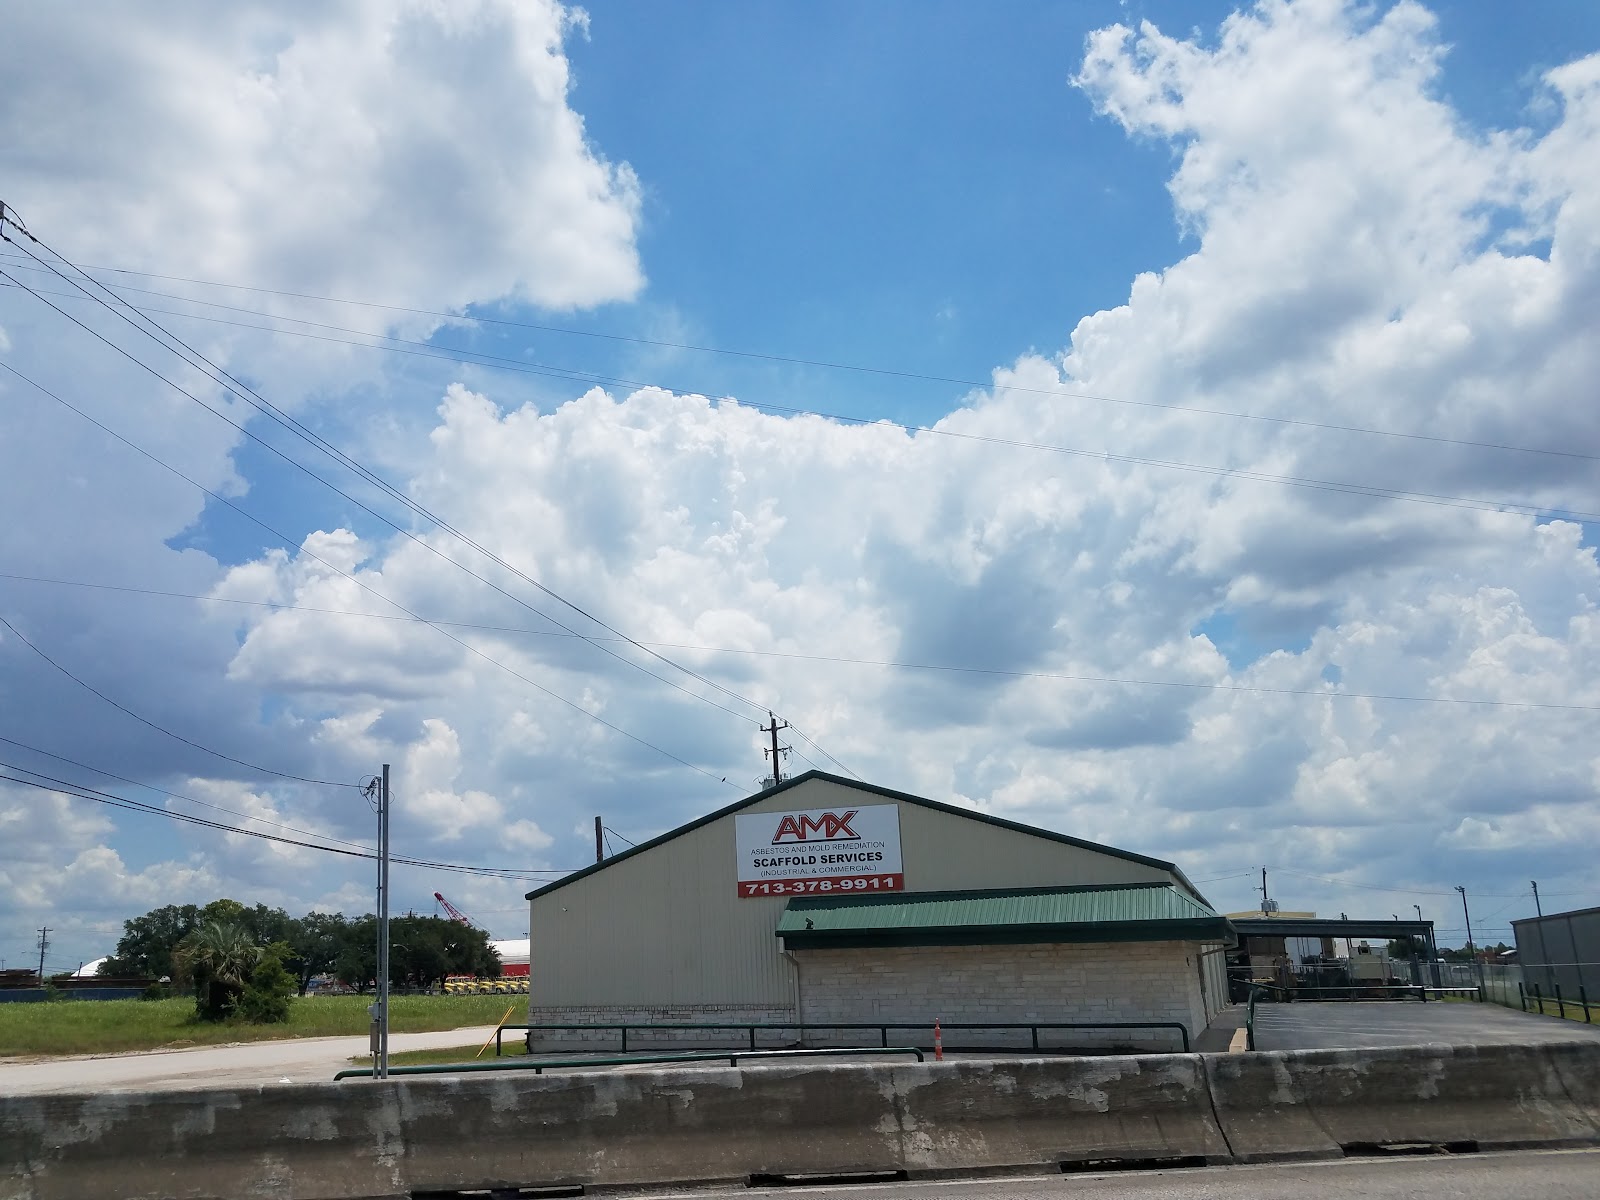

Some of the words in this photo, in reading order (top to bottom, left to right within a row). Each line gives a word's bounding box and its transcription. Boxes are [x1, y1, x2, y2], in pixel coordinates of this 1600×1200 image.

[772, 810, 861, 845] AMX
[751, 847, 790, 856] ASBESTOS
[791, 846, 807, 854] AND
[808, 844, 831, 852] MOLD
[832, 841, 885, 850] REMEDIATION
[753, 855, 817, 868] SCAFFOLD
[820, 851, 883, 864] SERVICES
[760, 869, 810, 878] (INDUSTRIAL
[818, 864, 877, 874] COMMERCIAL)
[745, 877, 895, 895] 713-378-9911
